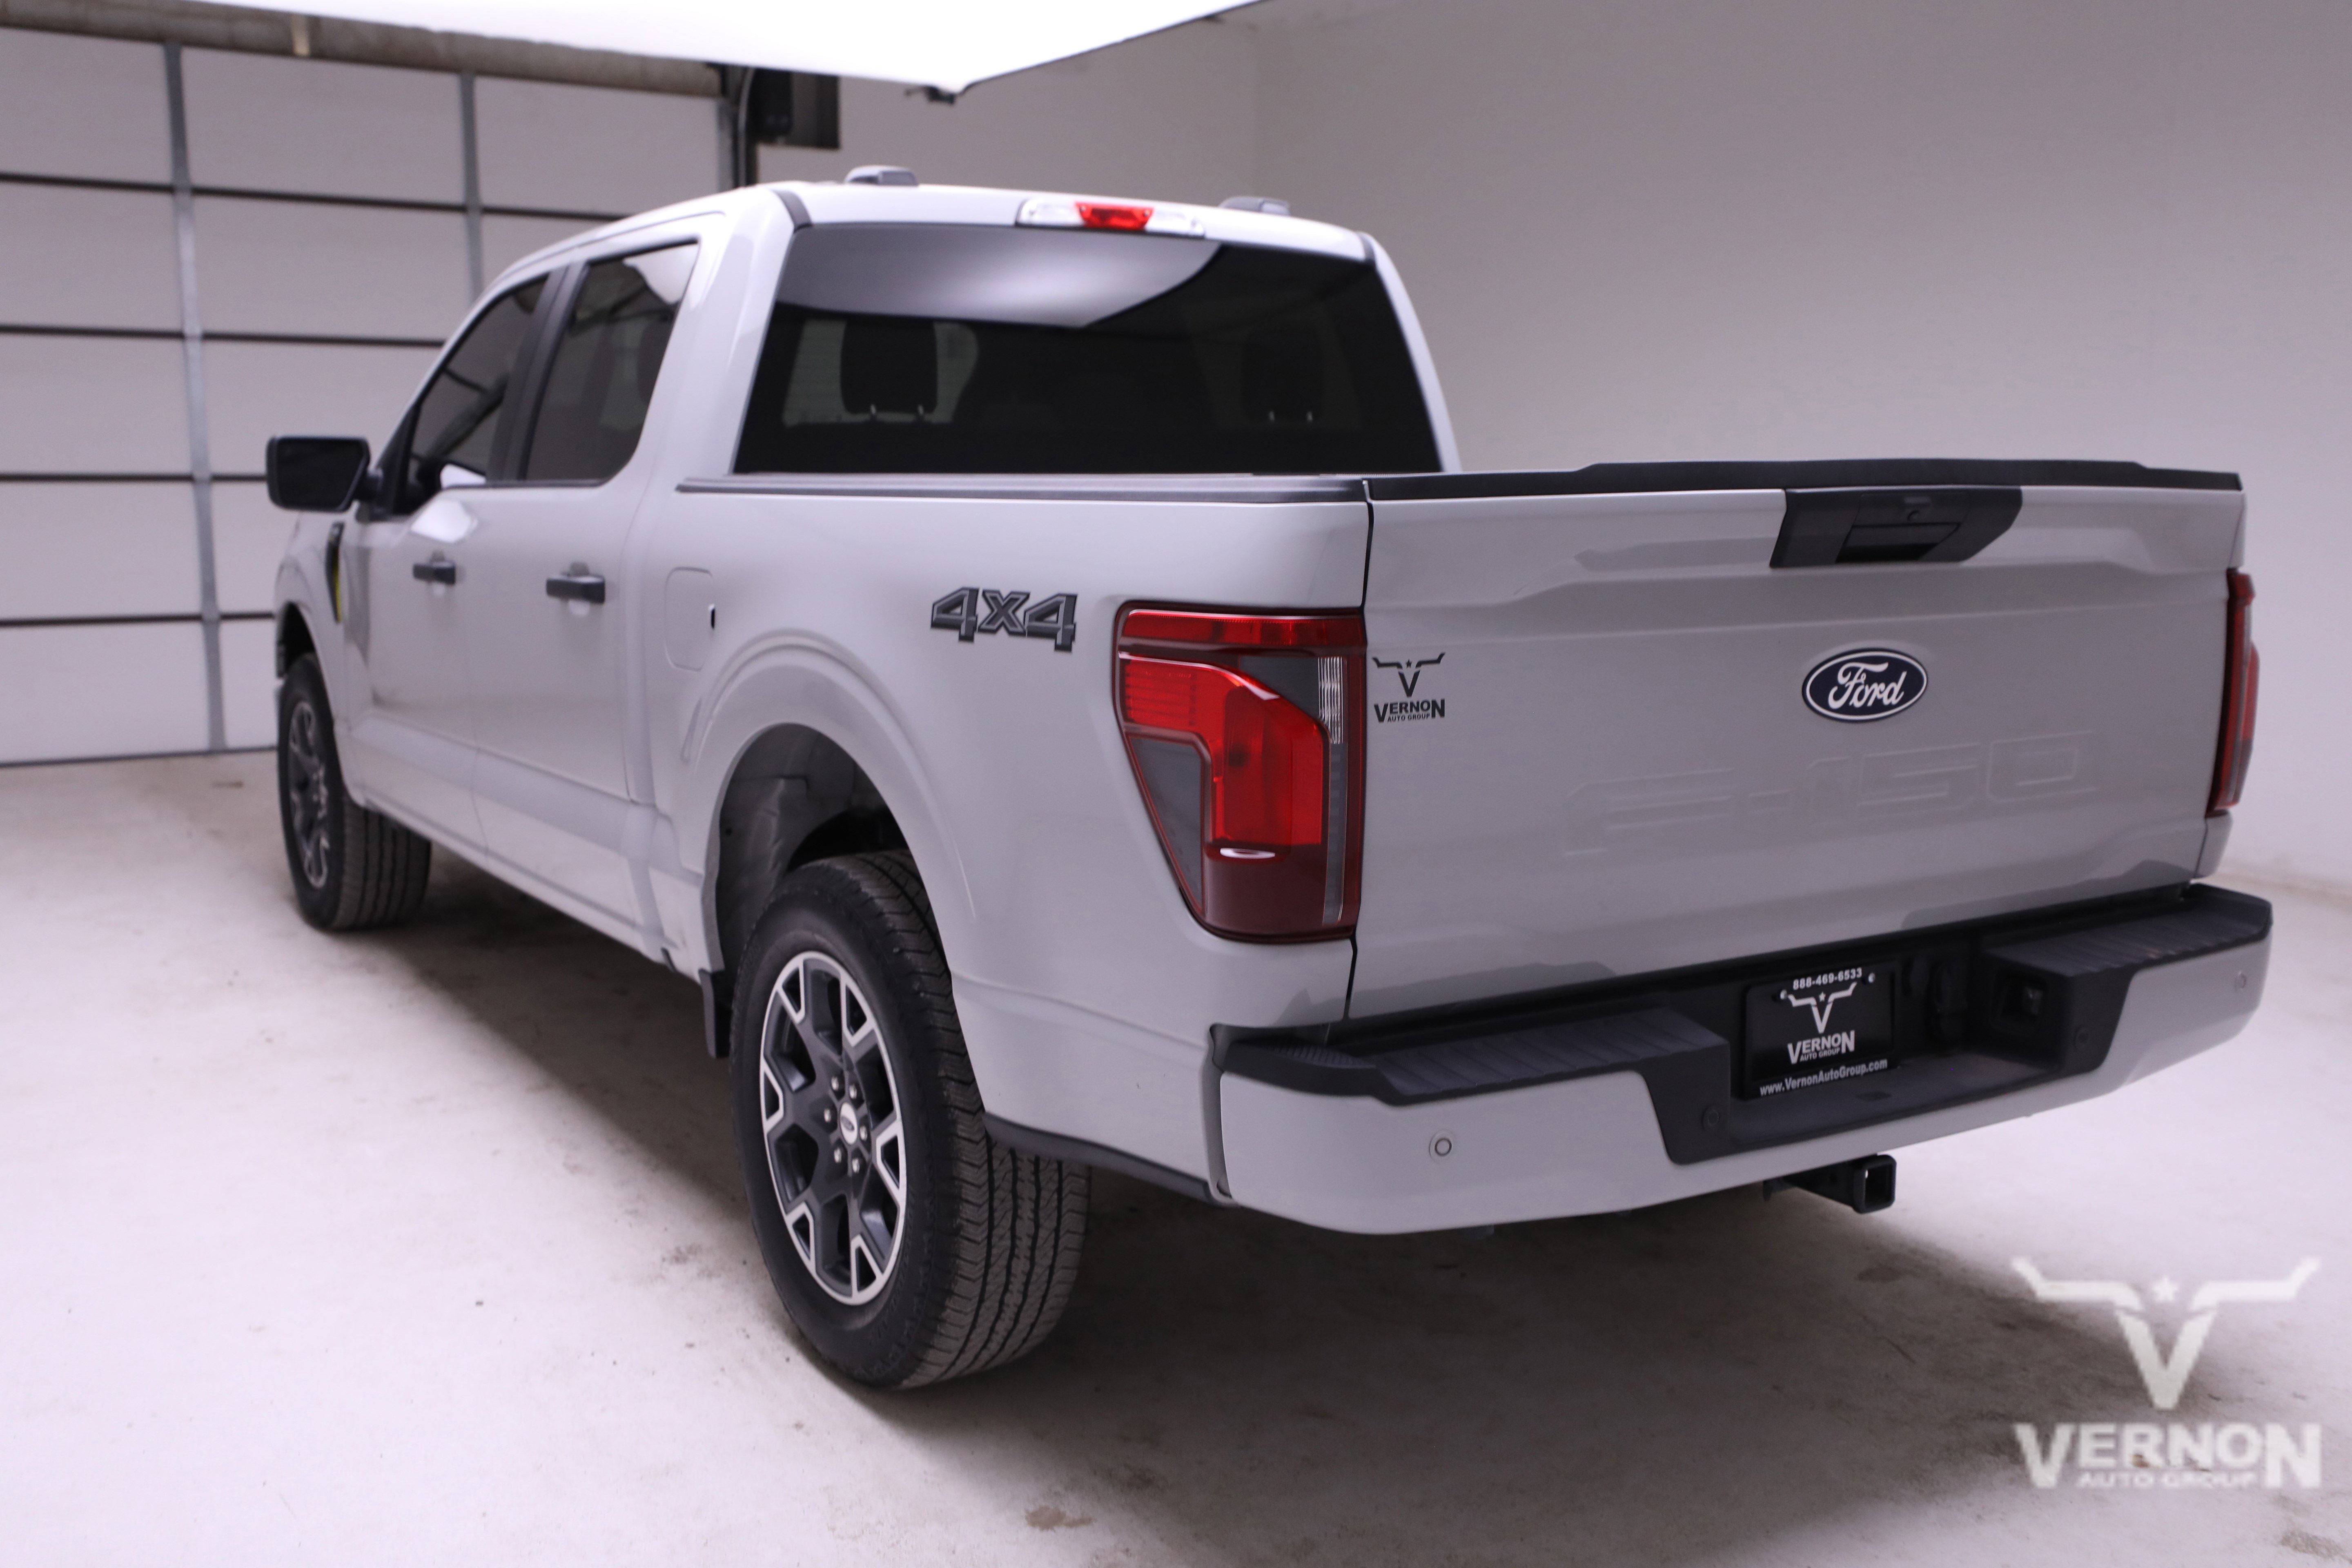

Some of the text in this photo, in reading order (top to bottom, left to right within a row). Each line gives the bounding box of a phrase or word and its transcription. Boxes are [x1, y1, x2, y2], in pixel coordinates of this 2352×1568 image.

[1828, 662, 1907, 709] Ford
[1374, 698, 1445, 723] VERNON
[1408, 713, 1430, 721] GROUP
[1562, 729, 2101, 858] F-150
[1793, 967, 1862, 990] 888-469-6533
[1787, 1030, 1855, 1064] VERNON
[1800, 1048, 1840, 1062] AUTO GROUP
[1760, 1059, 1888, 1096] www.VernonAutoGroup.com
